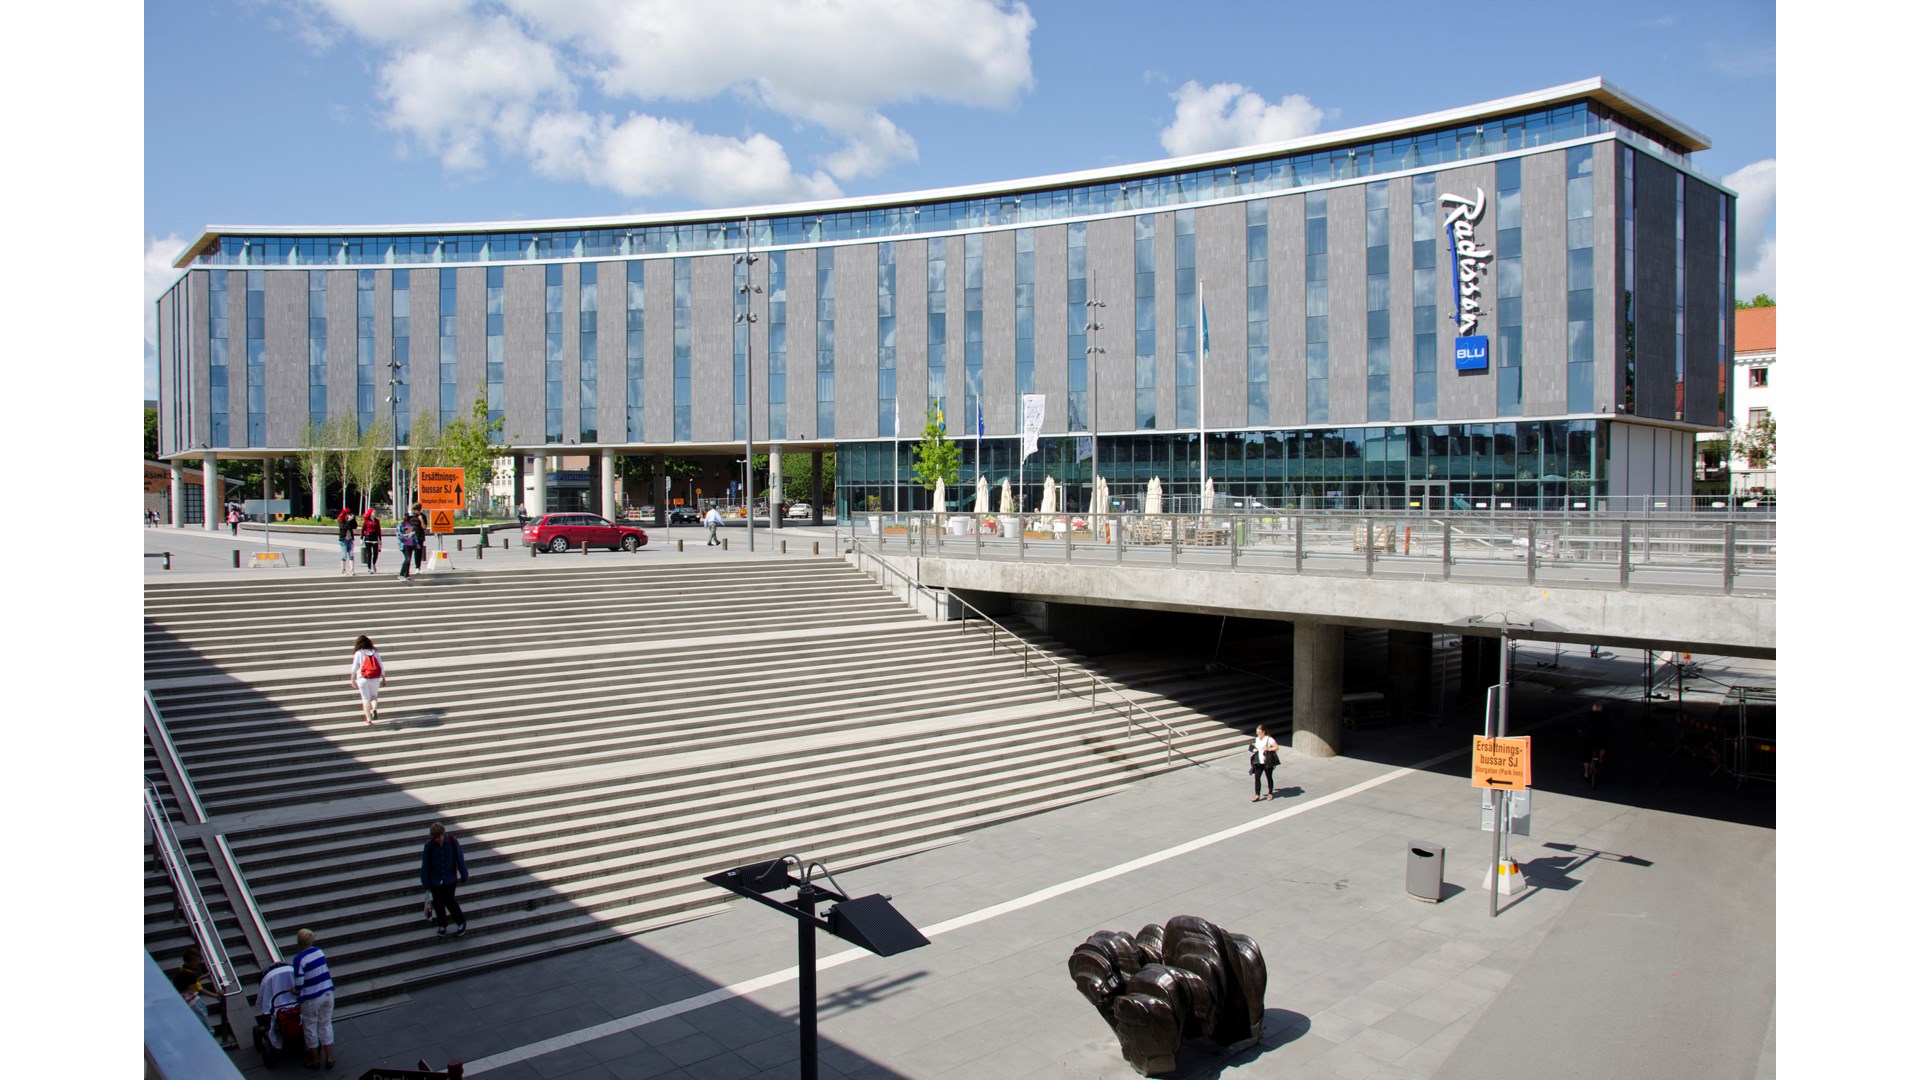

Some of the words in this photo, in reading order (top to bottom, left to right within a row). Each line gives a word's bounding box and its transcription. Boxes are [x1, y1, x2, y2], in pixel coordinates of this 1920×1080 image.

[1438, 187, 1492, 334] Radisson
[1456, 347, 1485, 360] BLU
[422, 472, 459, 483] Ersättnings-
[422, 484, 442, 493] bussar
[444, 484, 452, 493] SJ
[1480, 753, 1506, 766] bussar
[1508, 757, 1519, 768] SJ
[1475, 765, 1498, 775] Storgatan
